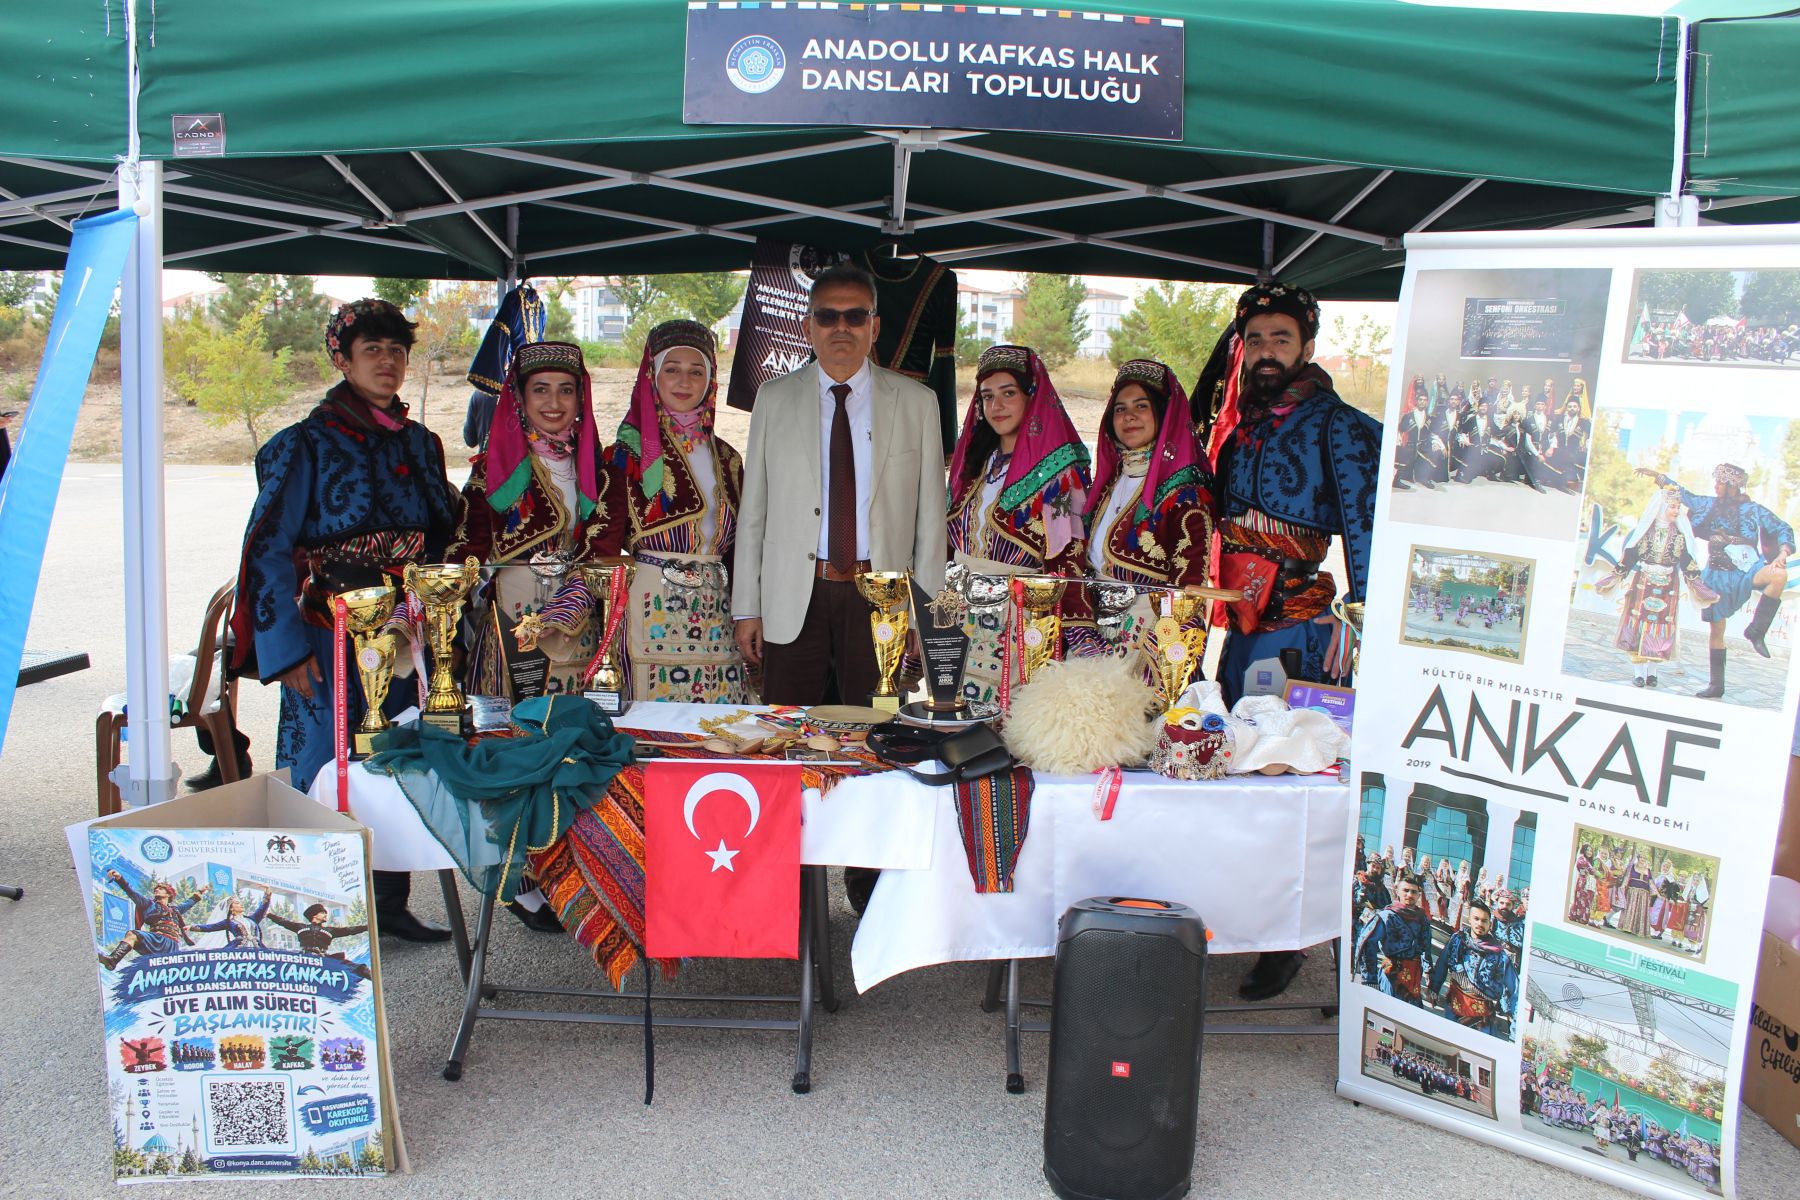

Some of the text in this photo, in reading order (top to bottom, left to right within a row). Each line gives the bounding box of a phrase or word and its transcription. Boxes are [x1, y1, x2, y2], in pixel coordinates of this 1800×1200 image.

[802, 39, 1160, 76] ANADOLU KAFKAS HALK
[801, 69, 949, 93] DANSLARI
[966, 73, 1142, 104] TOPLULUĞU
[1422, 667, 1473, 681] KÜLTÜR
[1400, 683, 1721, 808] ANKAF
[1406, 758, 1431, 769] 2019
[1579, 799, 1691, 831] DANS AKADEMİ
[263, 855, 302, 863] ANKAF
[149, 950, 324, 967] NECMETTİN ERBAKAN ÜNİVERSİTESİ
[127, 962, 349, 995] ANADOLU KAFKAS (ANKAF)
[164, 981, 318, 995] HALK DANSLARI TOPLULUĞU
[163, 993, 317, 1016] ÜYE ALIM SÜRECİ
[173, 1012, 318, 1036] BAŞLAMIŞTIR!
[134, 1063, 157, 1072] ZEYBEK
[327, 1106, 367, 1119] KAREKODU
[328, 1114, 369, 1128] OKUTUNUZ
